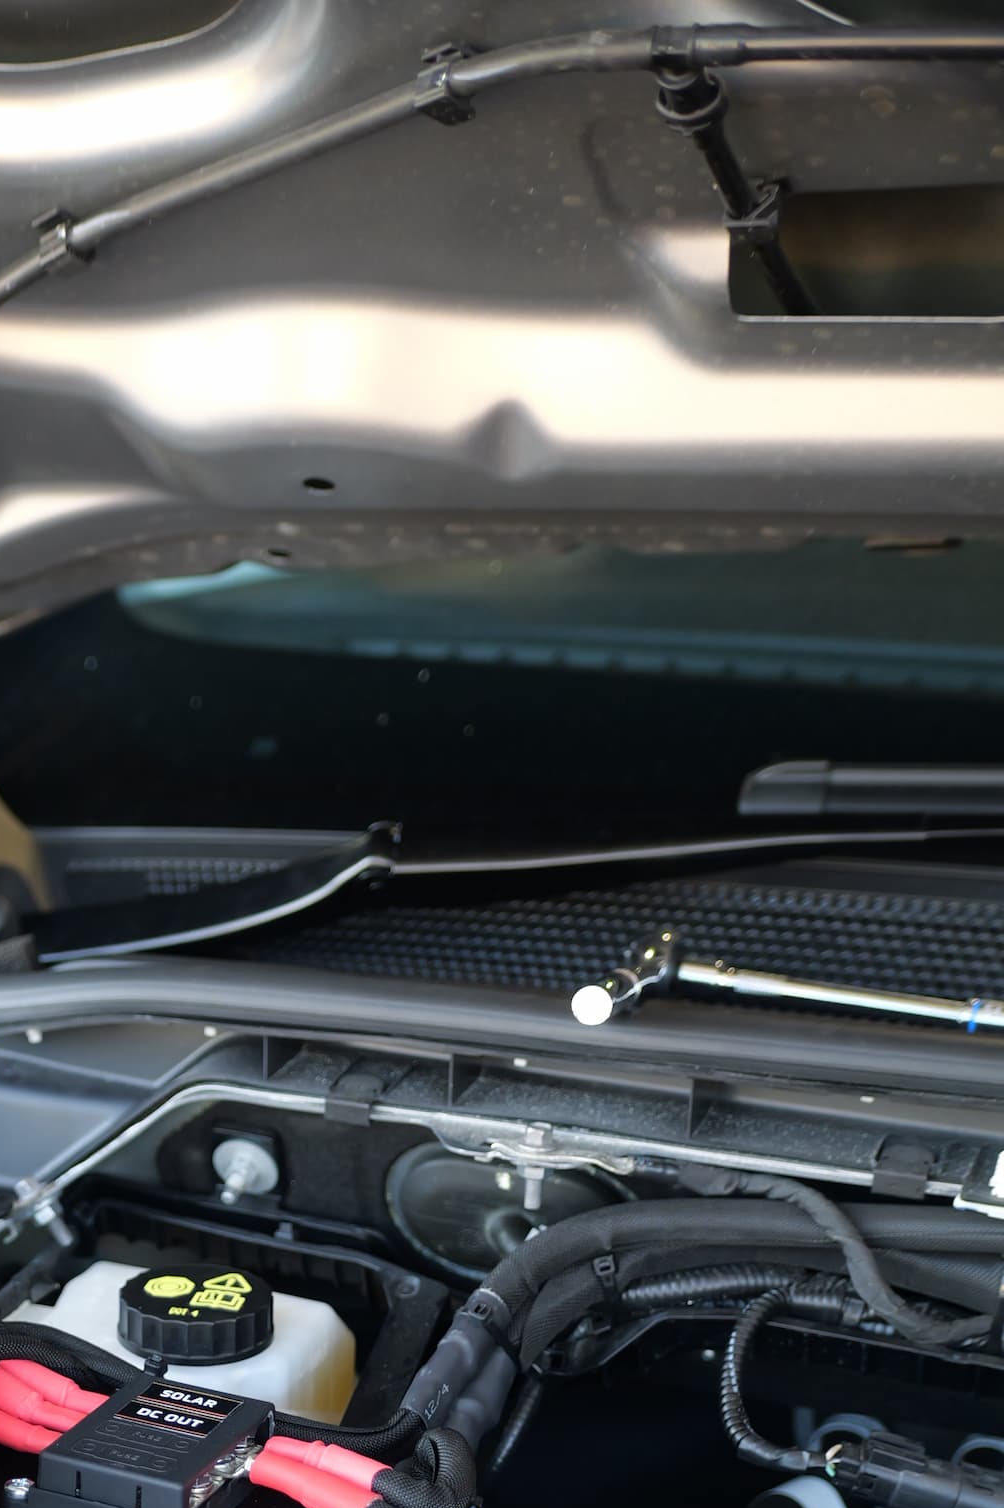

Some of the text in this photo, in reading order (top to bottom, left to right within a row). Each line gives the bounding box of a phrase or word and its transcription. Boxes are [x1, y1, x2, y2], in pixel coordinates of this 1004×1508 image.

[168, 1306, 189, 1317] DOT
[159, 1389, 218, 1408] SOLAR
[136, 1406, 204, 1428] DC OUT
